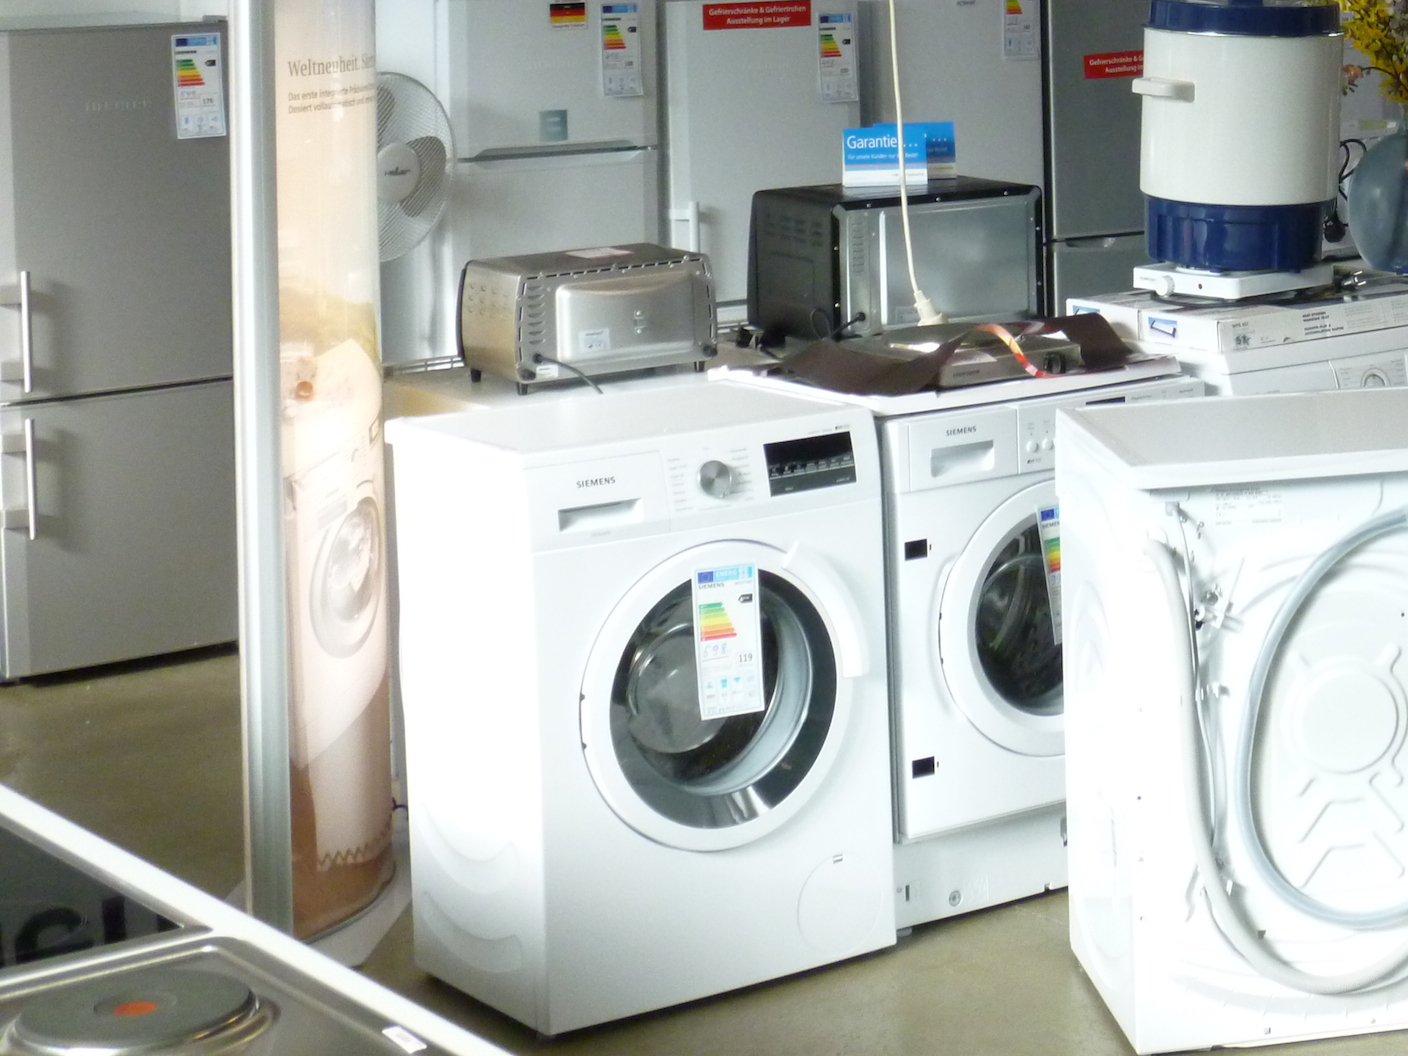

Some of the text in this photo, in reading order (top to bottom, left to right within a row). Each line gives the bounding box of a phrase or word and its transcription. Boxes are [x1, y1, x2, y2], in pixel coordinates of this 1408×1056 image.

[708, 5, 807, 16] Gefrierschränke & Gefriertruhen
[726, 17, 764, 26] Ausstellung
[773, 15, 791, 24] Lager
[1089, 57, 1133, 67] Gefrierschränke
[1105, 65, 1137, 74] Ausstellung
[288, 92, 300, 101] Das
[301, 91, 318, 100] erste
[288, 105, 312, 114] Dosiert
[846, 134, 898, 150] Garantie
[946, 425, 977, 437] SIEMENS
[576, 476, 616, 489] SIEMENS
[698, 582, 725, 590] SIEMENS
[738, 653, 753, 663] 119
